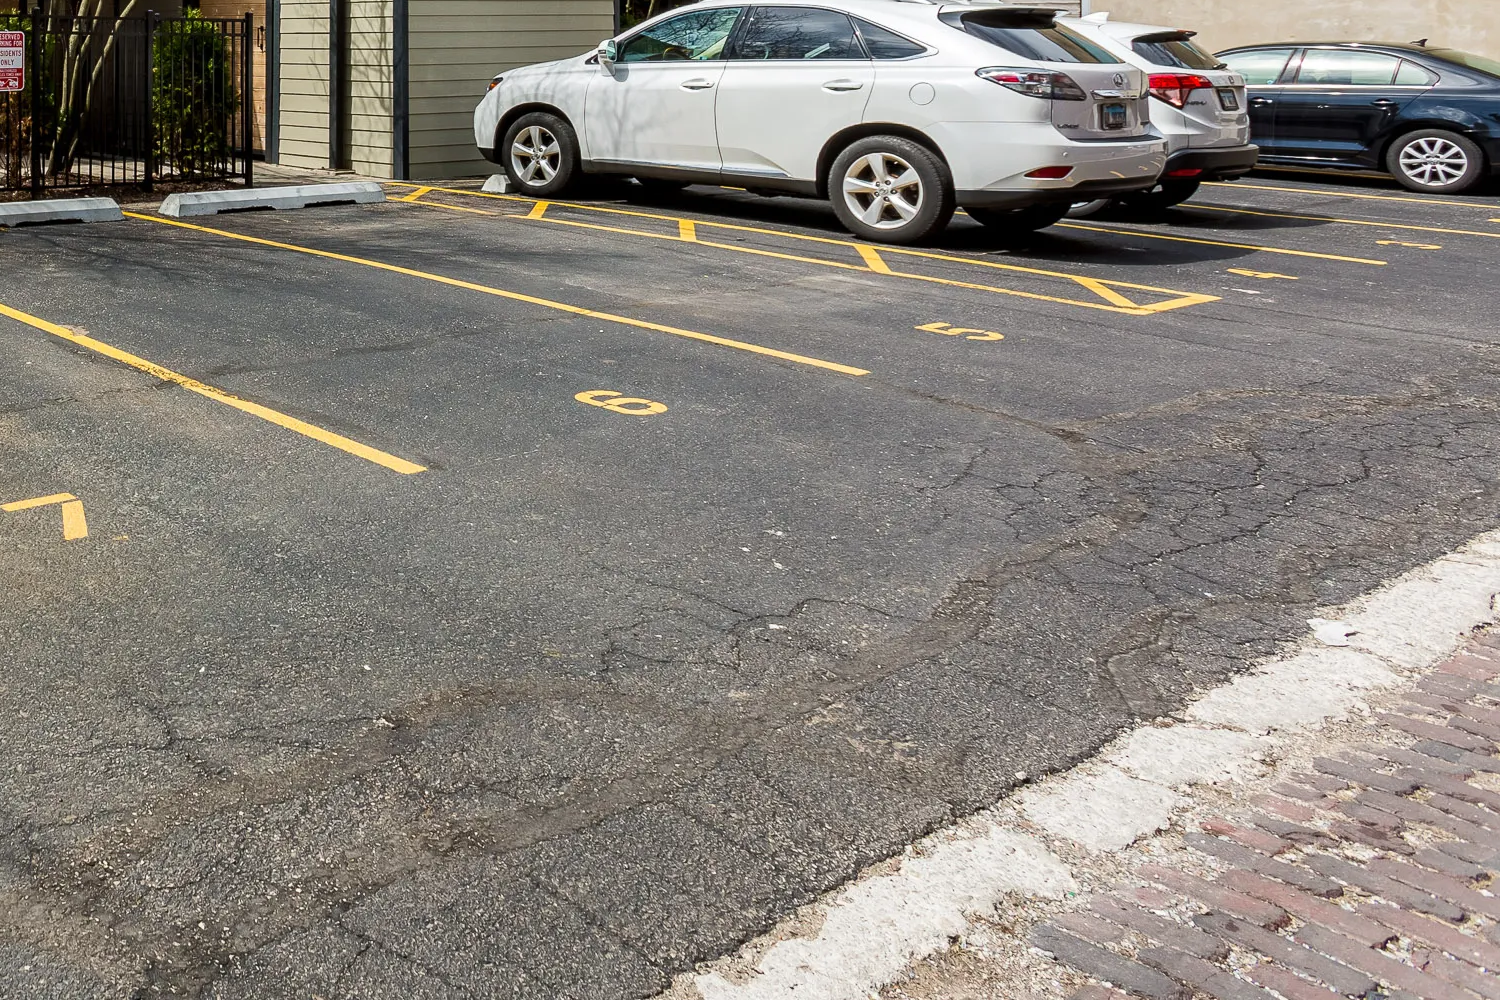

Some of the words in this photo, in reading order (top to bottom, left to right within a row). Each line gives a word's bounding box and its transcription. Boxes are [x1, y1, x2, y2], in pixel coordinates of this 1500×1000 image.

[914, 322, 1004, 341] 5
[574, 390, 668, 416] 6
[0, 492, 88, 541] 7
